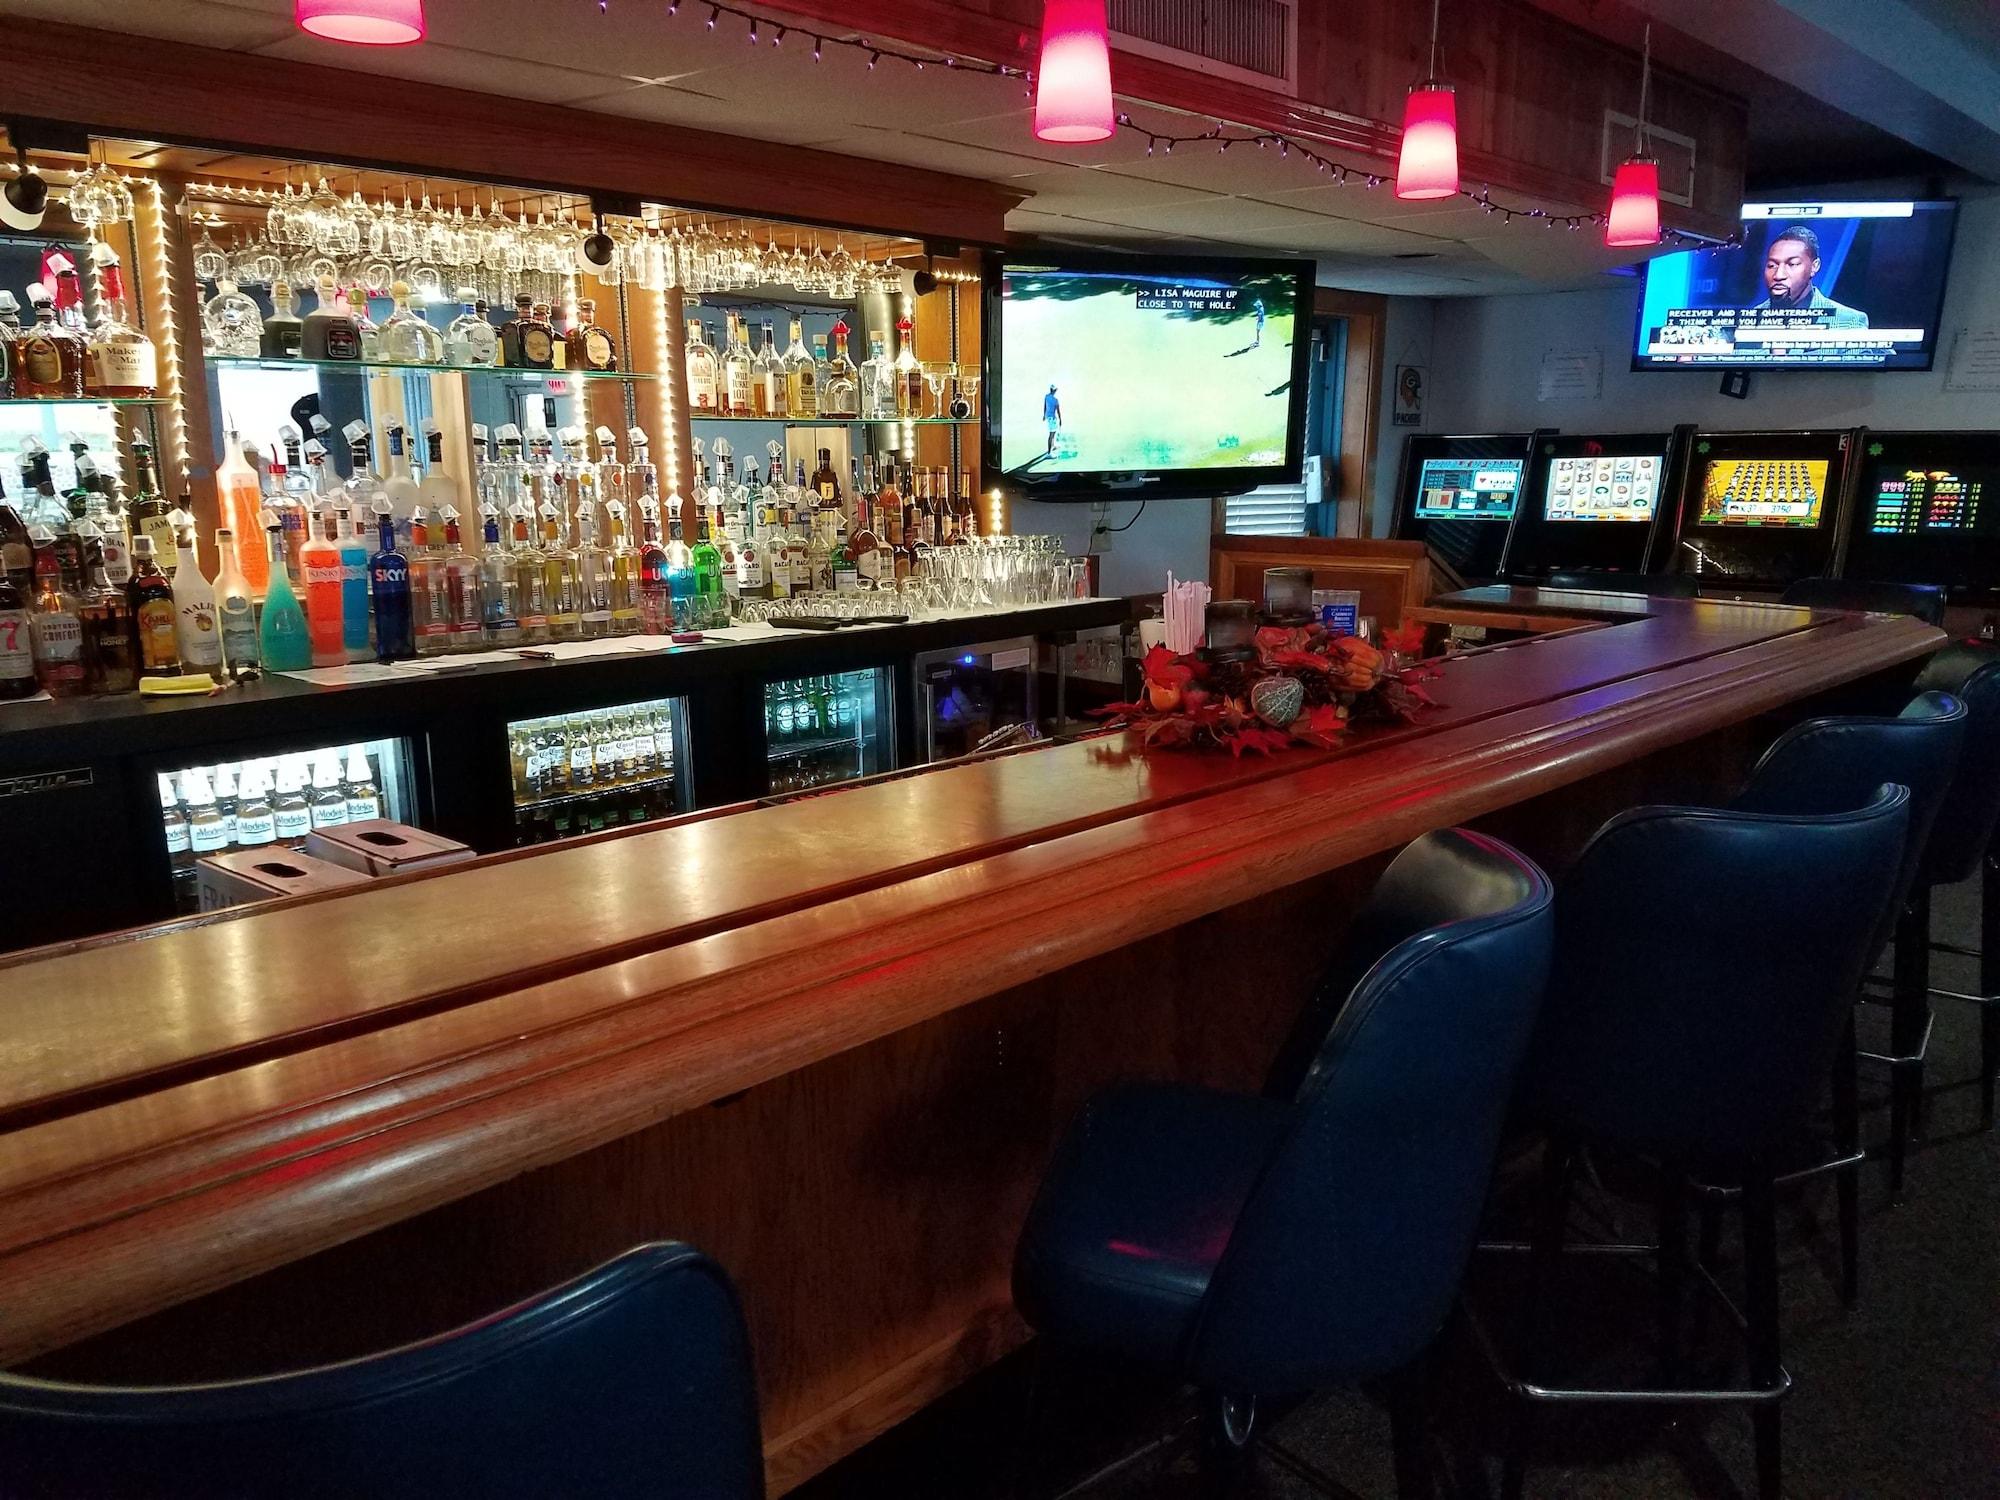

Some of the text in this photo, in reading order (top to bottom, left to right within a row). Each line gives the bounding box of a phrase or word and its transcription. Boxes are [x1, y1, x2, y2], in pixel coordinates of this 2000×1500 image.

[1154, 289, 1178, 298] LISA
[1182, 289, 1222, 299] MAGUIRE
[1226, 290, 1238, 299] UP
[1137, 299, 1236, 310] CLOSE TO THE HOLE.
[1668, 309, 1714, 317] RECEIVER
[1740, 309, 1758, 317] THE
[1762, 308, 1829, 317] QUARTERBACK.
[1679, 318, 1707, 326] THINK
[1711, 318, 1735, 326] WHEN
[1739, 318, 1757, 326] YOU
[1760, 317, 1784, 326] HAVE
[1788, 317, 1812, 325] SUCH
[106, 346, 141, 355] Make
[376, 568, 408, 582] SKYY
[0, 621, 19, 651] 7
